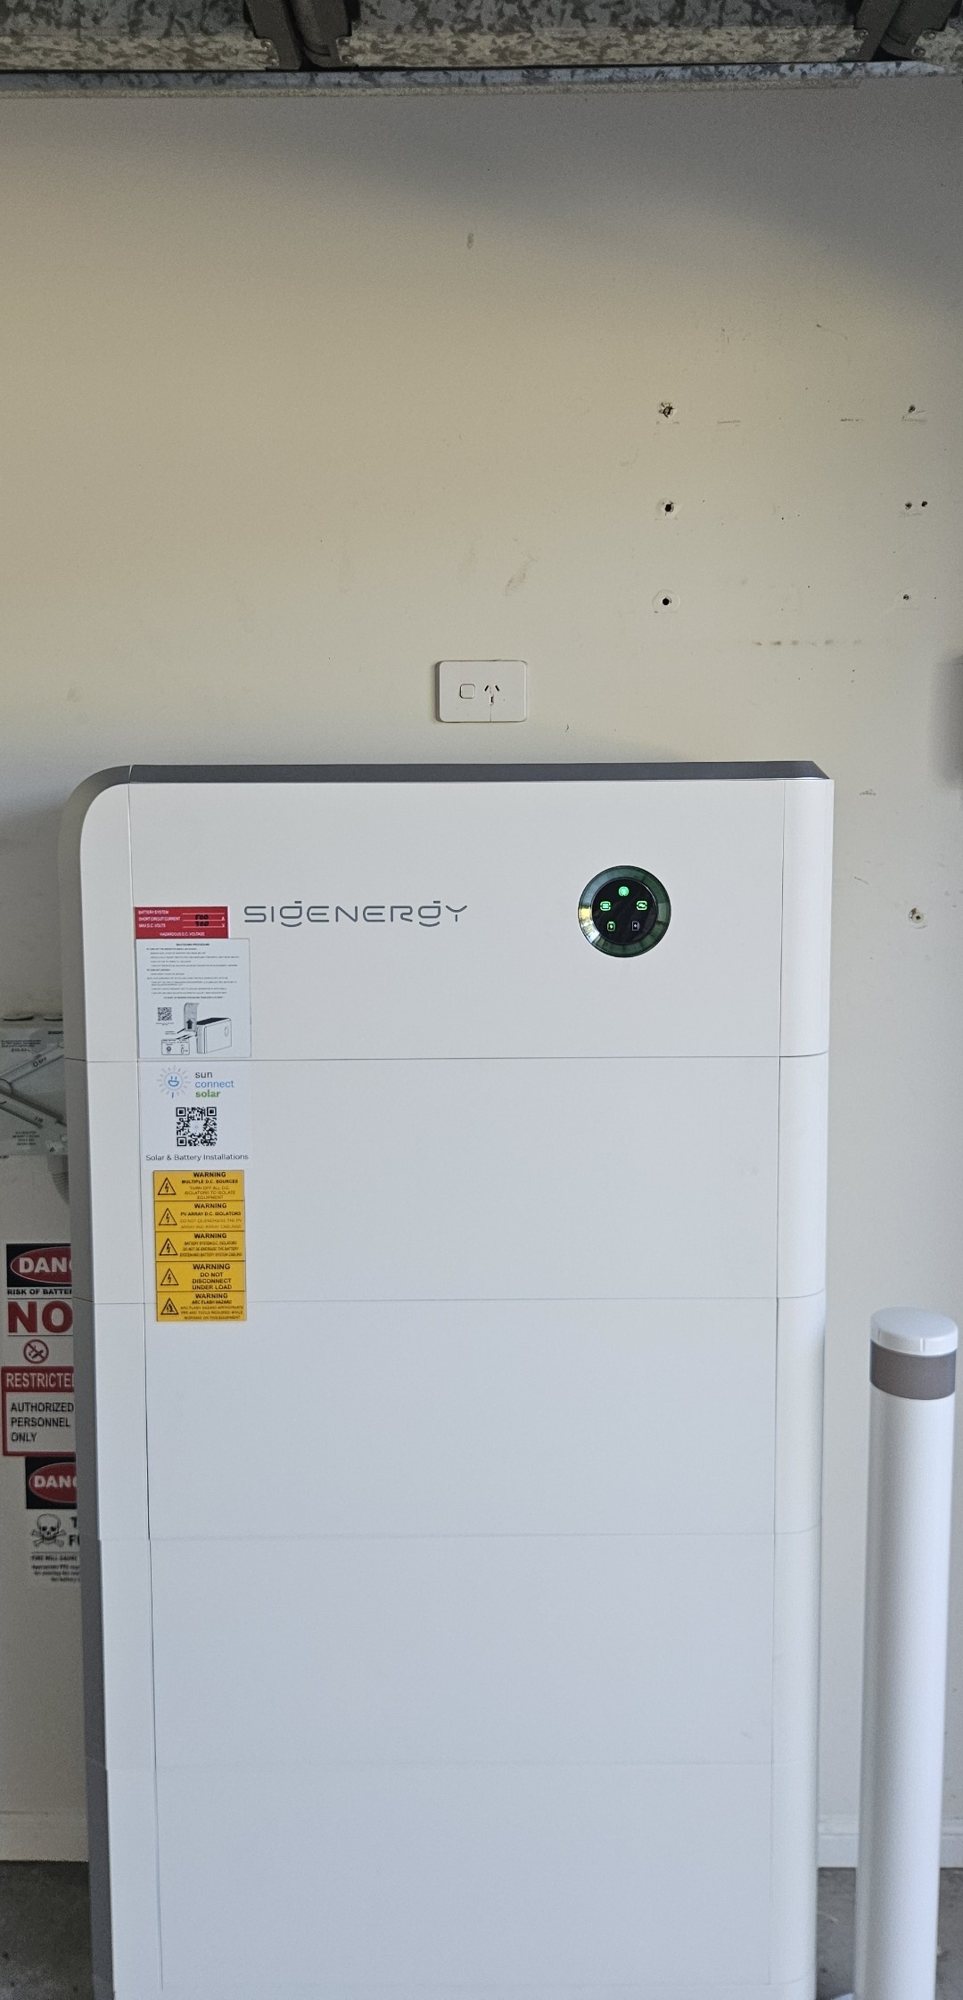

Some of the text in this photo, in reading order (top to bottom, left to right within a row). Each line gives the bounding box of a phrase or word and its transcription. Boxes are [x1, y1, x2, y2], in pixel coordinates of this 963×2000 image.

[195, 1071, 213, 1079] sun
[195, 1080, 235, 1089] connect
[196, 1089, 221, 1098] solar
[174, 1154, 201, 1162] Battery
[203, 1153, 249, 1161] Installations
[19, 1256, 72, 1273] DAN
[8, 1301, 73, 1334] NO
[6, 1372, 74, 1388] RESTRICTE
[10, 1402, 75, 1412] AUTHORIZED
[10, 1417, 71, 1427] PERSONNEL
[11, 1432, 38, 1442] ONLY
